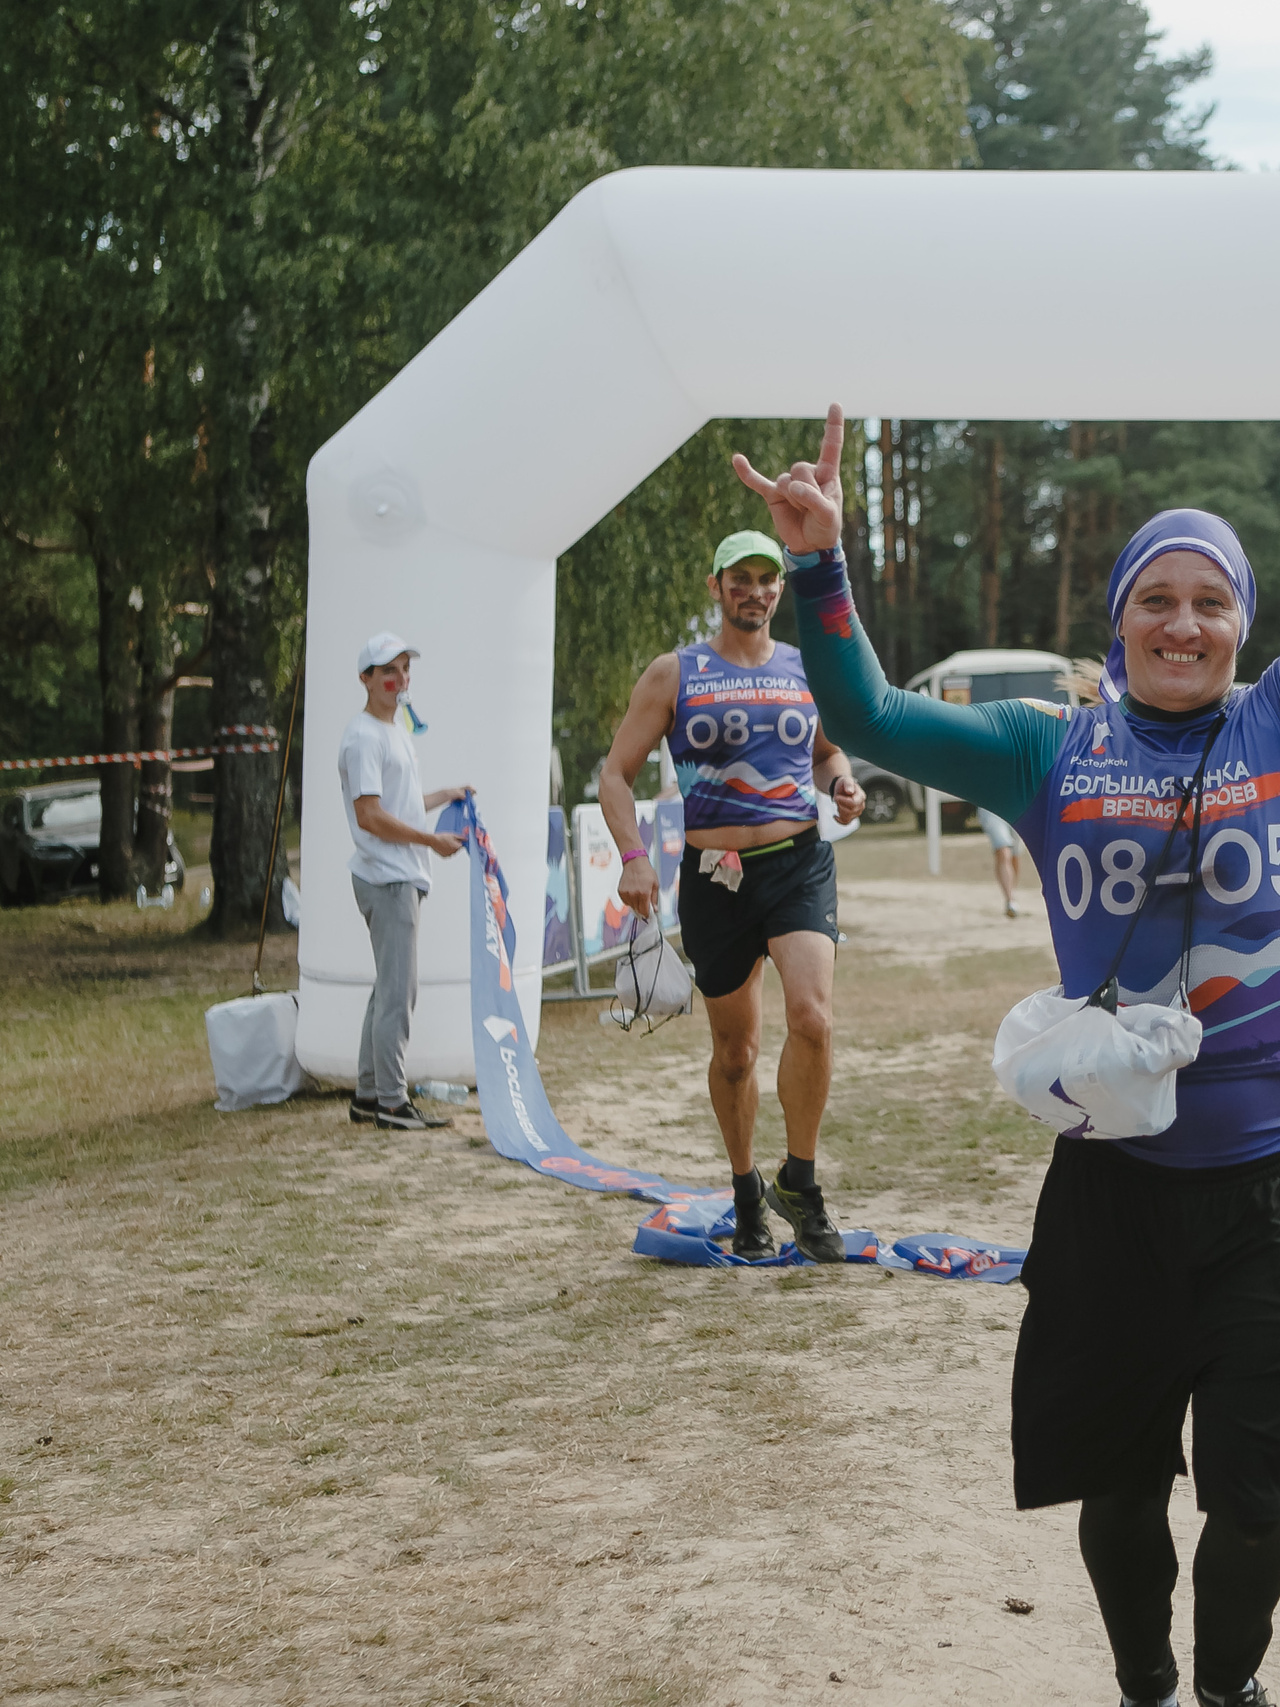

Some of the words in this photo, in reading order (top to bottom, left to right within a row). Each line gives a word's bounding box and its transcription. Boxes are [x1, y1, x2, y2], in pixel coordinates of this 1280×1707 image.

[686, 679, 753, 695] БОЛЬШАЯ
[755, 677, 799, 690] ГОНКА
[714, 690, 756, 702] ВРЕМЯ
[758, 688, 802, 702] ГЕРОЕВ
[1070, 756, 1128, 768] Ростелком
[1060, 774, 1175, 798] БОЛЬШАЯ
[1181, 760, 1250, 793] ГНКА
[1102, 798, 1177, 820] ВРЕМЯ
[1182, 782, 1258, 818] ЕРОЕВ
